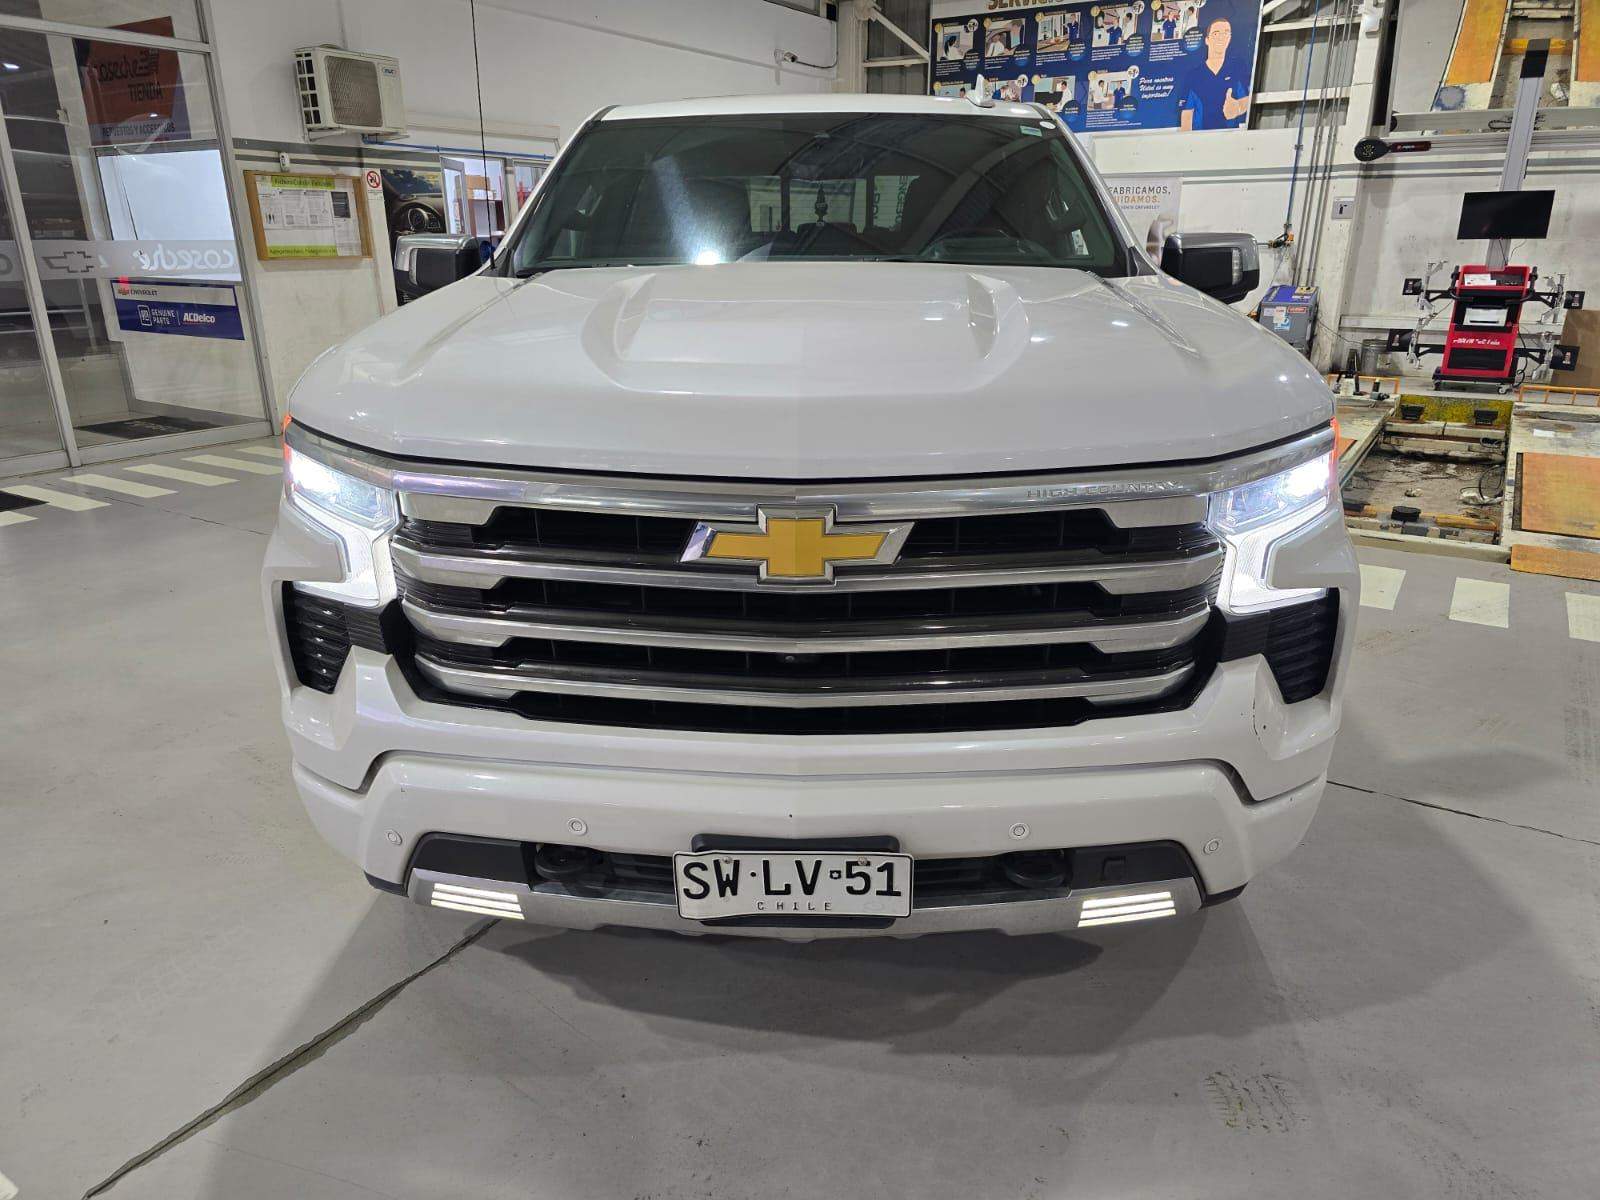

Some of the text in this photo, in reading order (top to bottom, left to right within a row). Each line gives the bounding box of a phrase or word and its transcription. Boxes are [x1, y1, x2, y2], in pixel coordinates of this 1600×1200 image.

[128, 81, 164, 102] TIENDA
[1111, 195, 1161, 205] UIDAMOS.
[183, 312, 216, 324] ACDelco
[1027, 481, 1184, 499] HIGH COUNTRY
[756, 901, 833, 911] CHILE
